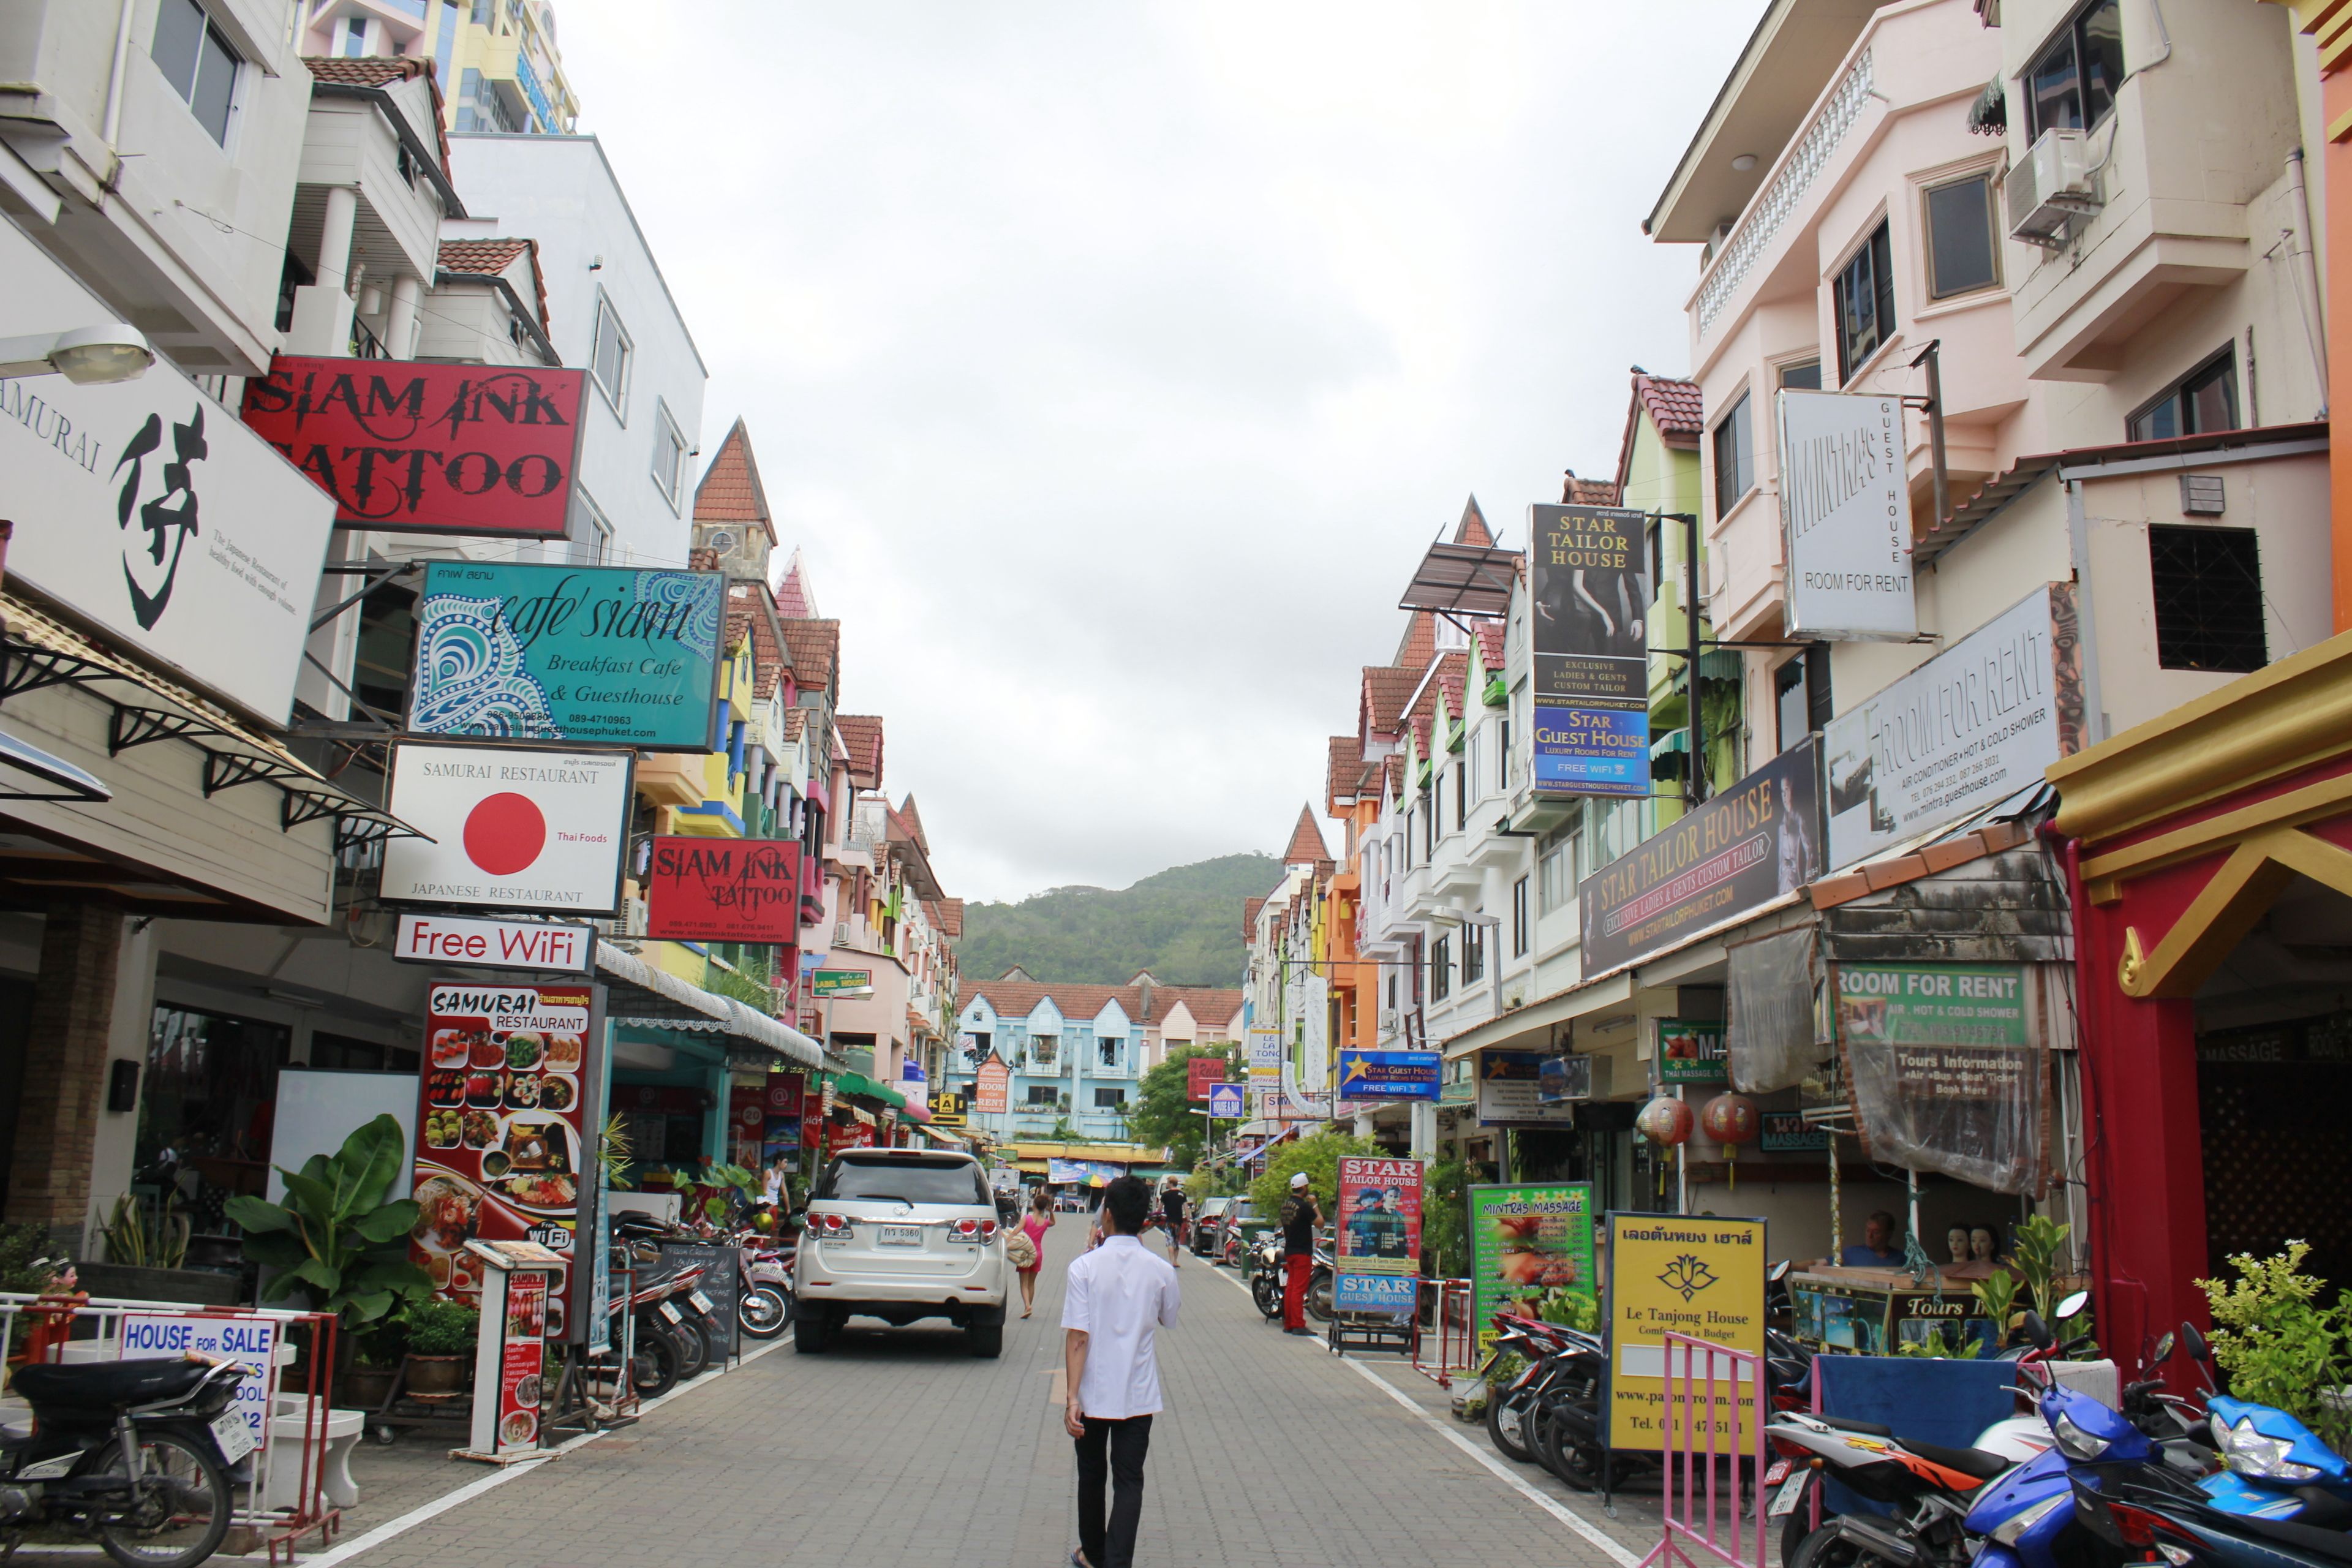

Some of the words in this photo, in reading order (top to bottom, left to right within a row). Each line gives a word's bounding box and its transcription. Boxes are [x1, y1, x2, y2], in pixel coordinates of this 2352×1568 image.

[251, 371, 429, 440] SIAM
[426, 373, 569, 440] INK
[1881, 402, 1893, 473] GUEST
[1888, 490, 1899, 563] HOUSE
[109, 401, 208, 631] 侍
[1560, 516, 1616, 533] STAR
[1548, 532, 1629, 551] TAILOR
[1551, 550, 1626, 568] HOUSE
[467, 569, 494, 581] สยาม
[1806, 571, 1844, 590] ROOM
[1847, 573, 1872, 591] FOR
[1875, 575, 1908, 592] RENT
[547, 654, 633, 676] Breakfast
[639, 657, 682, 679] Cafe
[1566, 661, 1615, 671] EXCLUSIVE
[1554, 671, 1587, 680] LADIES
[1598, 673, 1627, 682] GENTS
[551, 685, 567, 701] &
[575, 685, 684, 706] Guesthouse
[1554, 682, 1591, 691] CUSTOM
[1594, 683, 1626, 692] TAILOR
[1535, 698, 1646, 709] WWW.STARTAILORPHUKET.COM
[1880, 690, 1935, 777] ROOM
[1937, 668, 1982, 746] FOR
[1985, 628, 2043, 720] RENT
[569, 714, 631, 725] 089-4710963
[1902, 775, 1913, 790] AIR
[1913, 753, 1959, 786] CONDITIONER
[1963, 742, 1978, 760] HOT
[1980, 739, 1986, 751] &
[1987, 727, 2008, 749] COLD
[2010, 708, 2046, 736] SHOWER
[423, 762, 492, 778] SAMURAI
[500, 766, 599, 785] RESTAURANT
[1558, 763, 1587, 773] FREE
[1590, 765, 1611, 774] WIFI
[1537, 780, 1647, 791] WWW.STARGUESTHOUSEPHUKET.COM
[1910, 791, 1921, 803] TEL
[1923, 787, 1934, 799] 076
[1934, 784, 1944, 795] 294
[1959, 772, 1970, 786] 087
[1972, 768, 1983, 780] 266
[1984, 755, 2000, 774] 3031
[1903, 767, 2007, 823] www.mintra.guesthouse.com
[557, 832, 578, 842] Thai
[579, 833, 608, 843] Foods
[1602, 864, 1638, 911] STAR
[1639, 824, 1700, 889] TAILOR
[1703, 778, 1773, 853] HOUSE
[657, 848, 732, 885] SIAM
[739, 846, 793, 880] INK
[412, 882, 481, 898] JAPANESE
[489, 887, 584, 903] RESTAURANT
[1606, 903, 1638, 933] EXCLUSIVE
[1640, 891, 1664, 918] LADIES
[1665, 889, 1671, 900] &
[1672, 874, 1696, 900] GENTS
[1697, 858, 1730, 889] CUSTOM
[1733, 839, 1765, 870] TAILOR
[712, 882, 793, 918] TATTOO
[1627, 885, 1734, 947] WWW.STARTAILORPHUKET.COM
[659, 928, 783, 939] www.siaminktattoo.com
[412, 921, 487, 958] Free
[499, 928, 575, 965] WiFi
[1838, 972, 1899, 995] ROOM
[1907, 974, 1951, 997] FOR
[1958, 977, 2018, 999] RENT
[432, 991, 536, 1015] SAMURAI
[1888, 1005, 1904, 1015] AIR
[1913, 1005, 1934, 1016] HOT
[1937, 1006, 1944, 1016] &
[1947, 1006, 1973, 1017] COLD
[1977, 1006, 2019, 1019] SHOWER
[497, 1016, 584, 1030] RESTAURANT
[1899, 1054, 1939, 1067] Tours
[1943, 1055, 2023, 1070] Information
[1987, 1072, 2019, 1083] Ticket
[979, 1082, 1006, 1091] ROOM
[1936, 1084, 1960, 1094] Book
[1965, 1085, 1988, 1095] Here
[978, 1098, 1005, 1107] RENT
[745, 1110, 760, 1120] 20
[1766, 1133, 1823, 1147] MASSAGE
[1346, 1160, 1418, 1177] STAR
[1344, 1175, 1381, 1185] TAILOR
[1384, 1177, 1418, 1186] HOUSE
[1483, 1202, 1529, 1215] MINTRAS
[1533, 1200, 1582, 1214] MASSAGE
[900, 1228, 919, 1237] 5360
[1623, 1226, 1707, 1243] เลอตันหยง
[1714, 1229, 1753, 1245] เฮาส์
[510, 1273, 546, 1286] SAMURAI
[1343, 1278, 1412, 1294] STAR
[1340, 1292, 1375, 1302] GUEST
[1378, 1294, 1415, 1303] HOUSE
[1908, 1297, 1963, 1316] Tours
[1626, 1306, 1643, 1320] Le
[1648, 1308, 1702, 1326] Tanjong
[1707, 1310, 1749, 1325] House
[126, 1324, 193, 1351] HOUSE
[197, 1337, 216, 1351] FOR
[221, 1327, 271, 1354] SALE
[1703, 1329, 1735, 1340] Budget
[1630, 1417, 1653, 1430] Tel.
